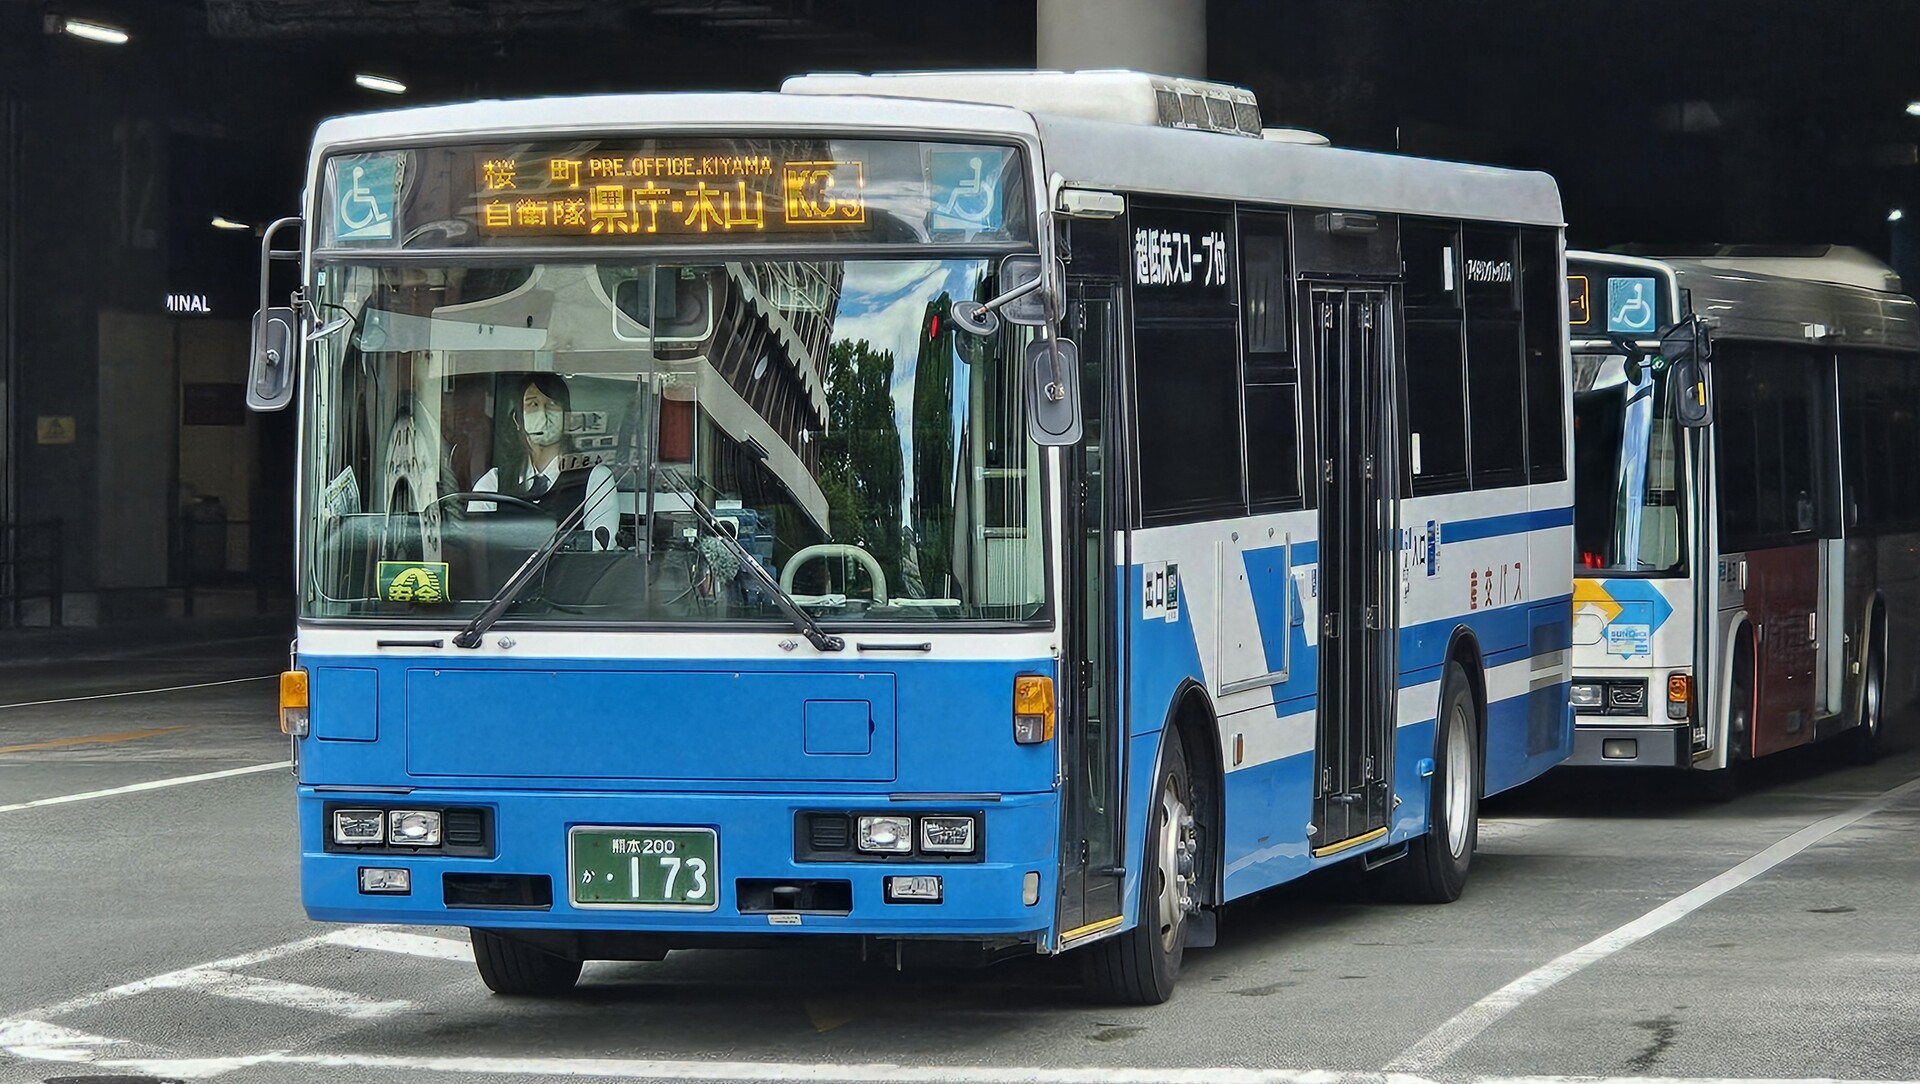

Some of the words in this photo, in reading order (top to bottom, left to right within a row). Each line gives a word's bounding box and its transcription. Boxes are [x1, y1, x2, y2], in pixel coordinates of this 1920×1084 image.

[486, 199, 587, 226] 自衛隊
[581, 869, 596, 884] か
